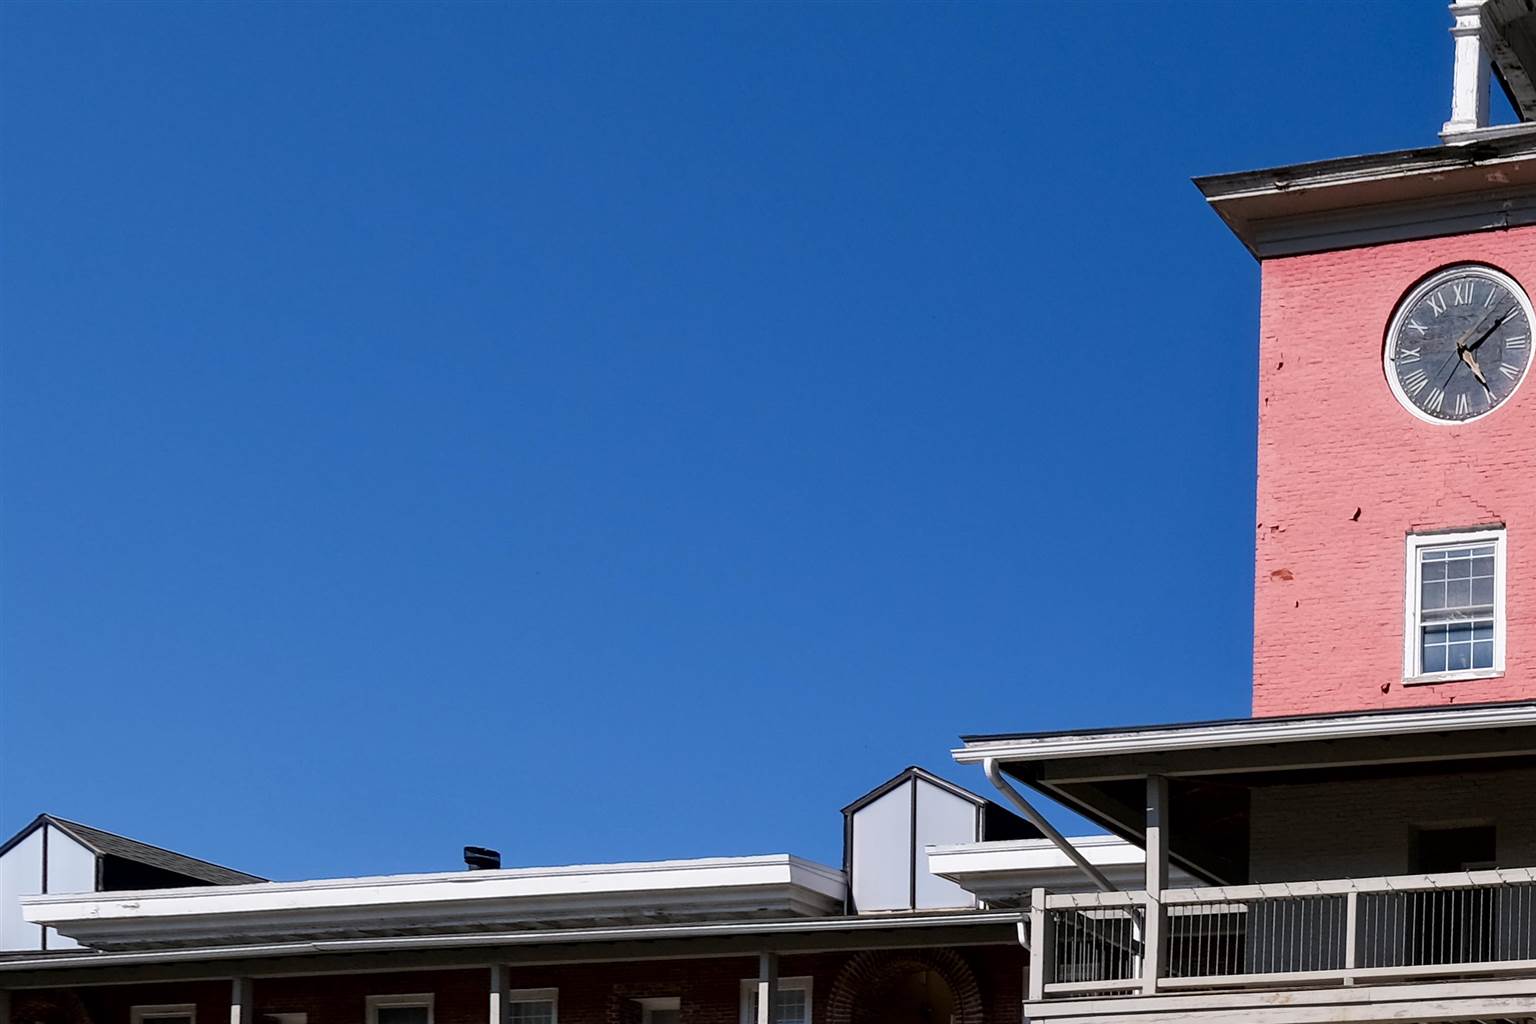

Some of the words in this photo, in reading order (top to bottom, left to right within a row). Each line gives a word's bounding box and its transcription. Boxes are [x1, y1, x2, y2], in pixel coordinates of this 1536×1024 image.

[1454, 283, 1474, 306] XII
[1427, 291, 1447, 317] XI
[1408, 319, 1428, 335] X
[1505, 335, 1526, 349] III
[1400, 347, 1420, 365] IX
